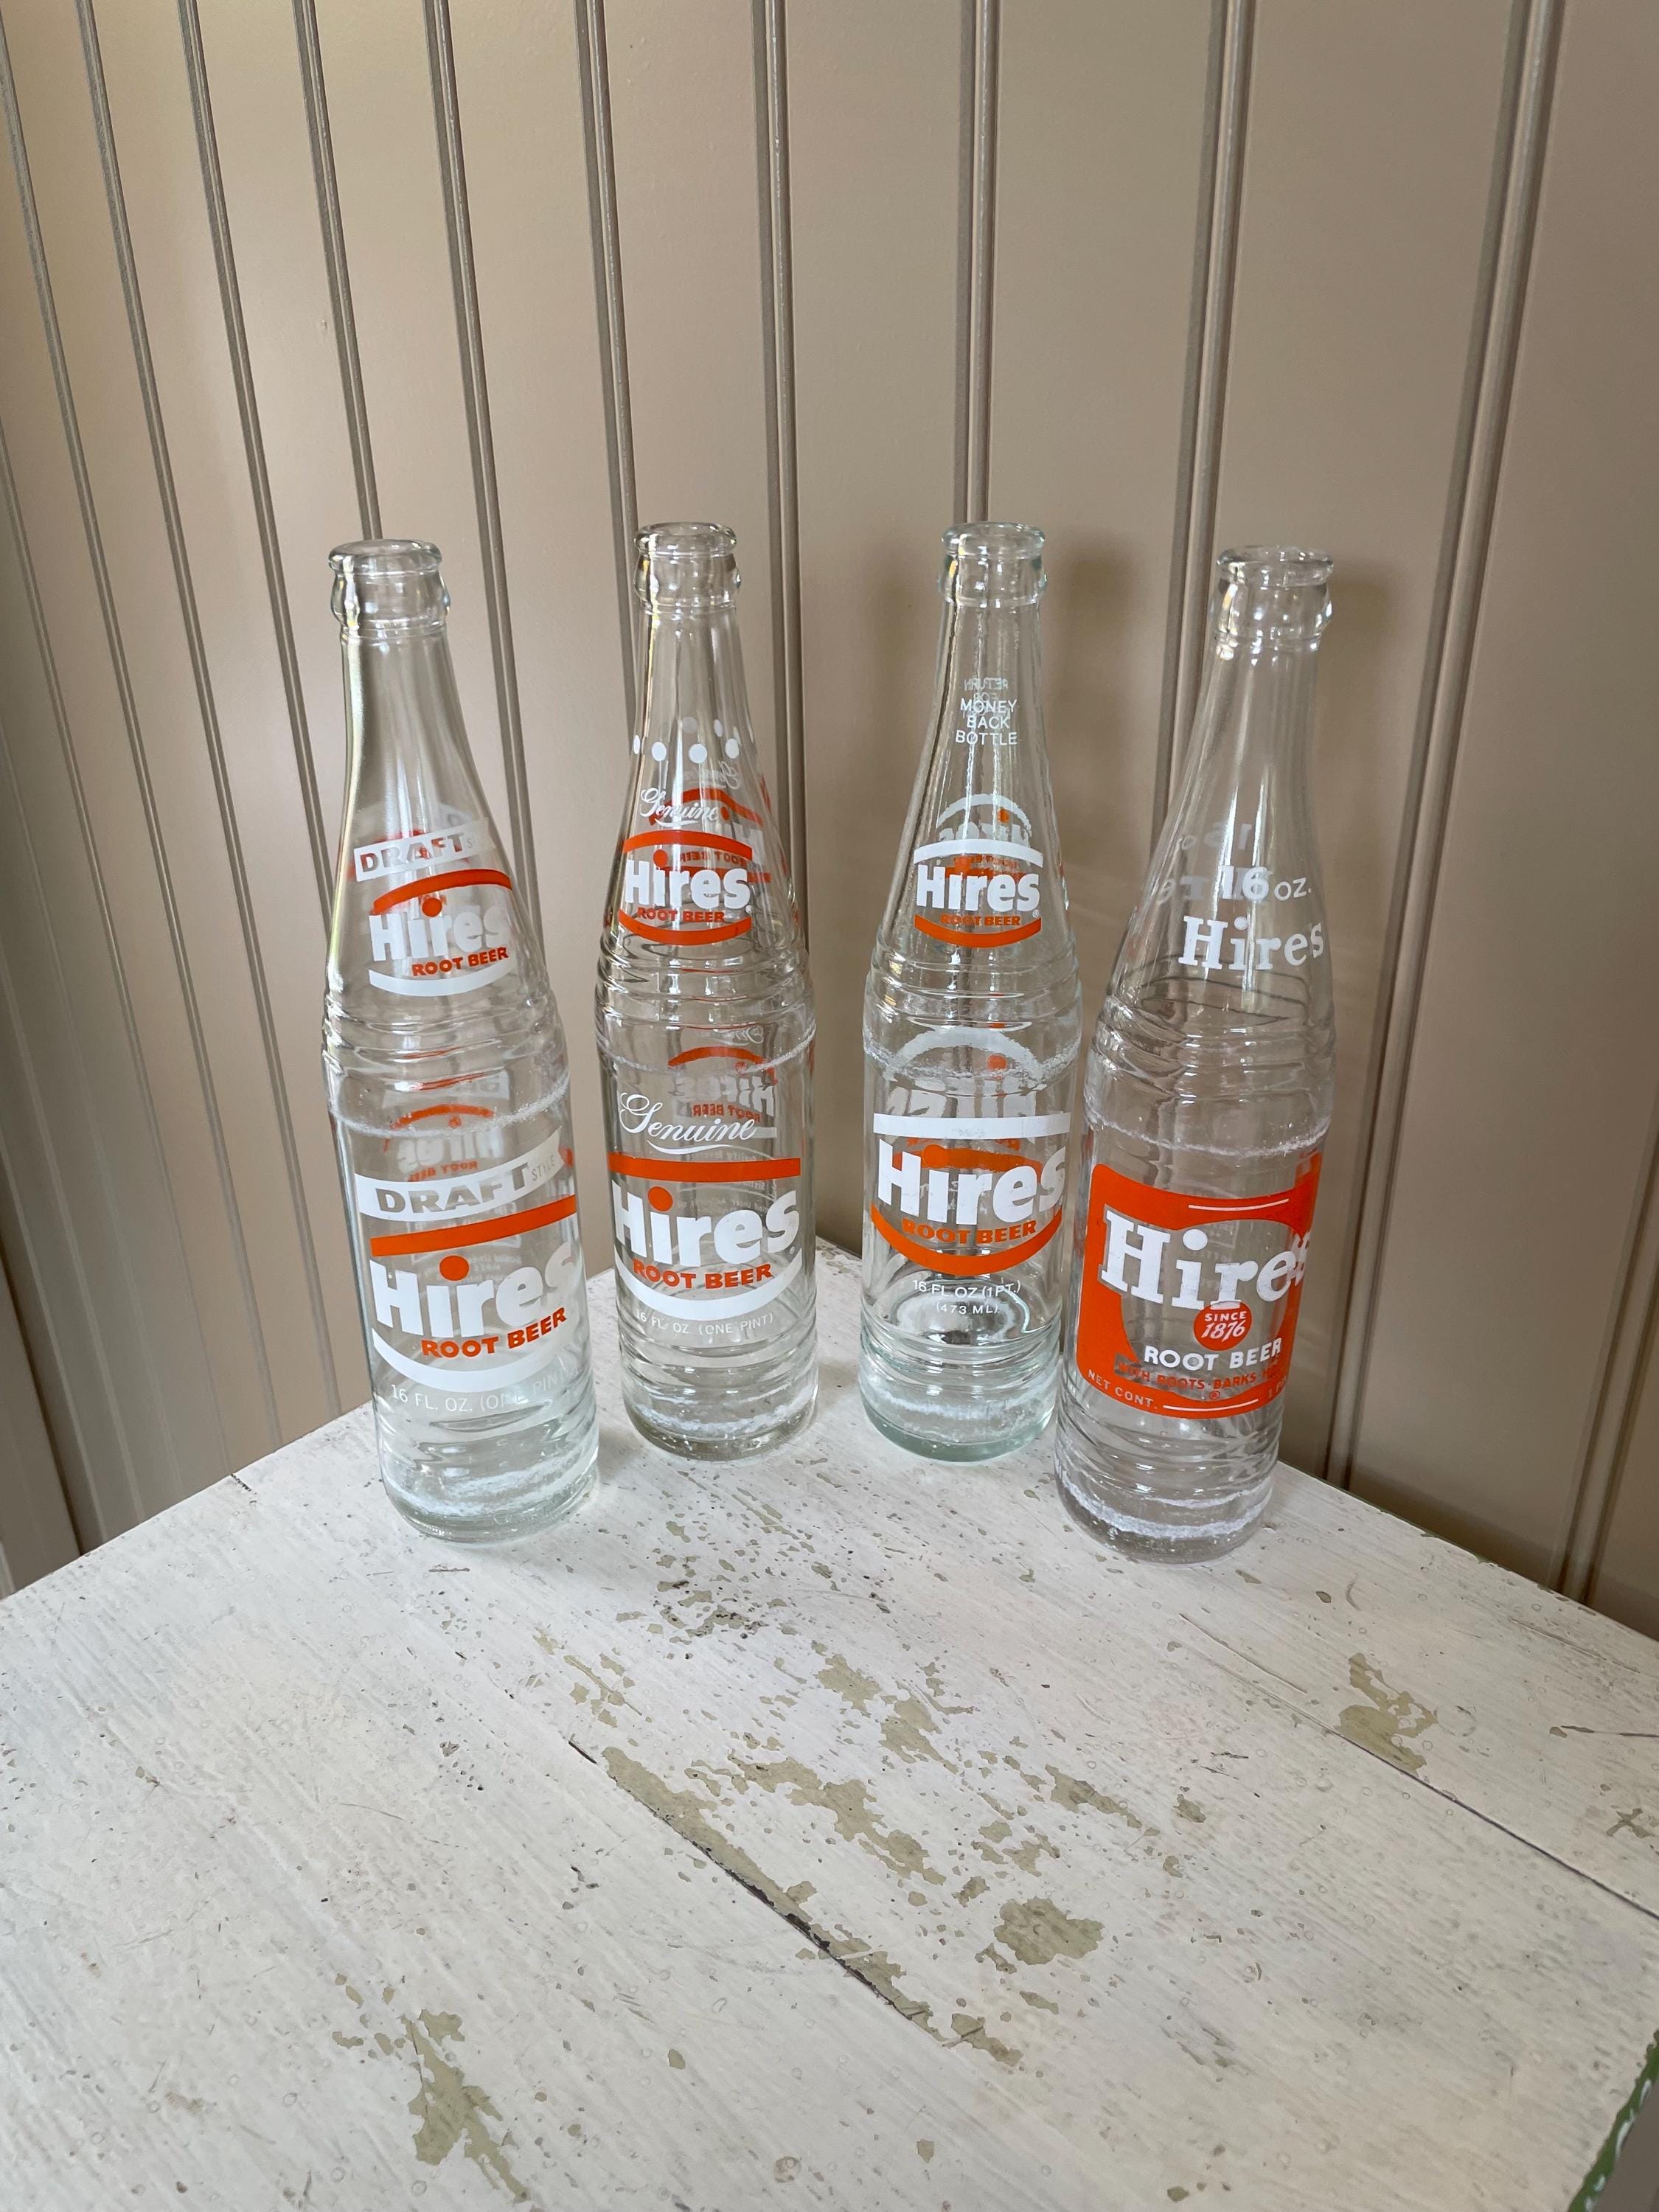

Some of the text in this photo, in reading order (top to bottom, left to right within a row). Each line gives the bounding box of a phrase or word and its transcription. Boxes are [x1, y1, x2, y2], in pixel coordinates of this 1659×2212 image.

[960, 698, 1018, 713] MONEY
[967, 716, 1010, 729] BACK
[955, 729, 1018, 745] BOTTLE
[360, 832, 465, 873] DRAFT
[624, 849, 751, 909] Hires
[916, 858, 1040, 912] Hires
[1221, 865, 1270, 901] 16
[369, 897, 509, 961] Hires
[637, 907, 725, 923] ROOT BEER
[940, 914, 1021, 926] ROOT BEER
[1178, 916, 1324, 970] Hires
[412, 946, 509, 976] ROOT BEER
[619, 1093, 757, 1142] Genuine
[377, 1161, 529, 1214] DRAFT
[877, 1138, 1066, 1225] Hires
[611, 1180, 799, 1267] Hires
[901, 1218, 1037, 1244] ROOT BEER
[369, 1240, 580, 1338] Hires
[633, 1259, 773, 1290] ROOT BEER
[913, 1280, 927, 1293] 16
[421, 1306, 567, 1359] ROOT BEER
[1200, 1320, 1246, 1342] 1876
[1204, 1311, 1248, 1323] SINCE
[1144, 1345, 1219, 1371] ROOT
[1229, 1337, 1282, 1370] BEER
[391, 1384, 408, 1403] 16
[414, 1393, 439, 1411] FL.
[445, 1397, 473, 1413] OZ.
[1088, 1368, 1111, 1391] NET
[1114, 1388, 1158, 1410] CONT.
